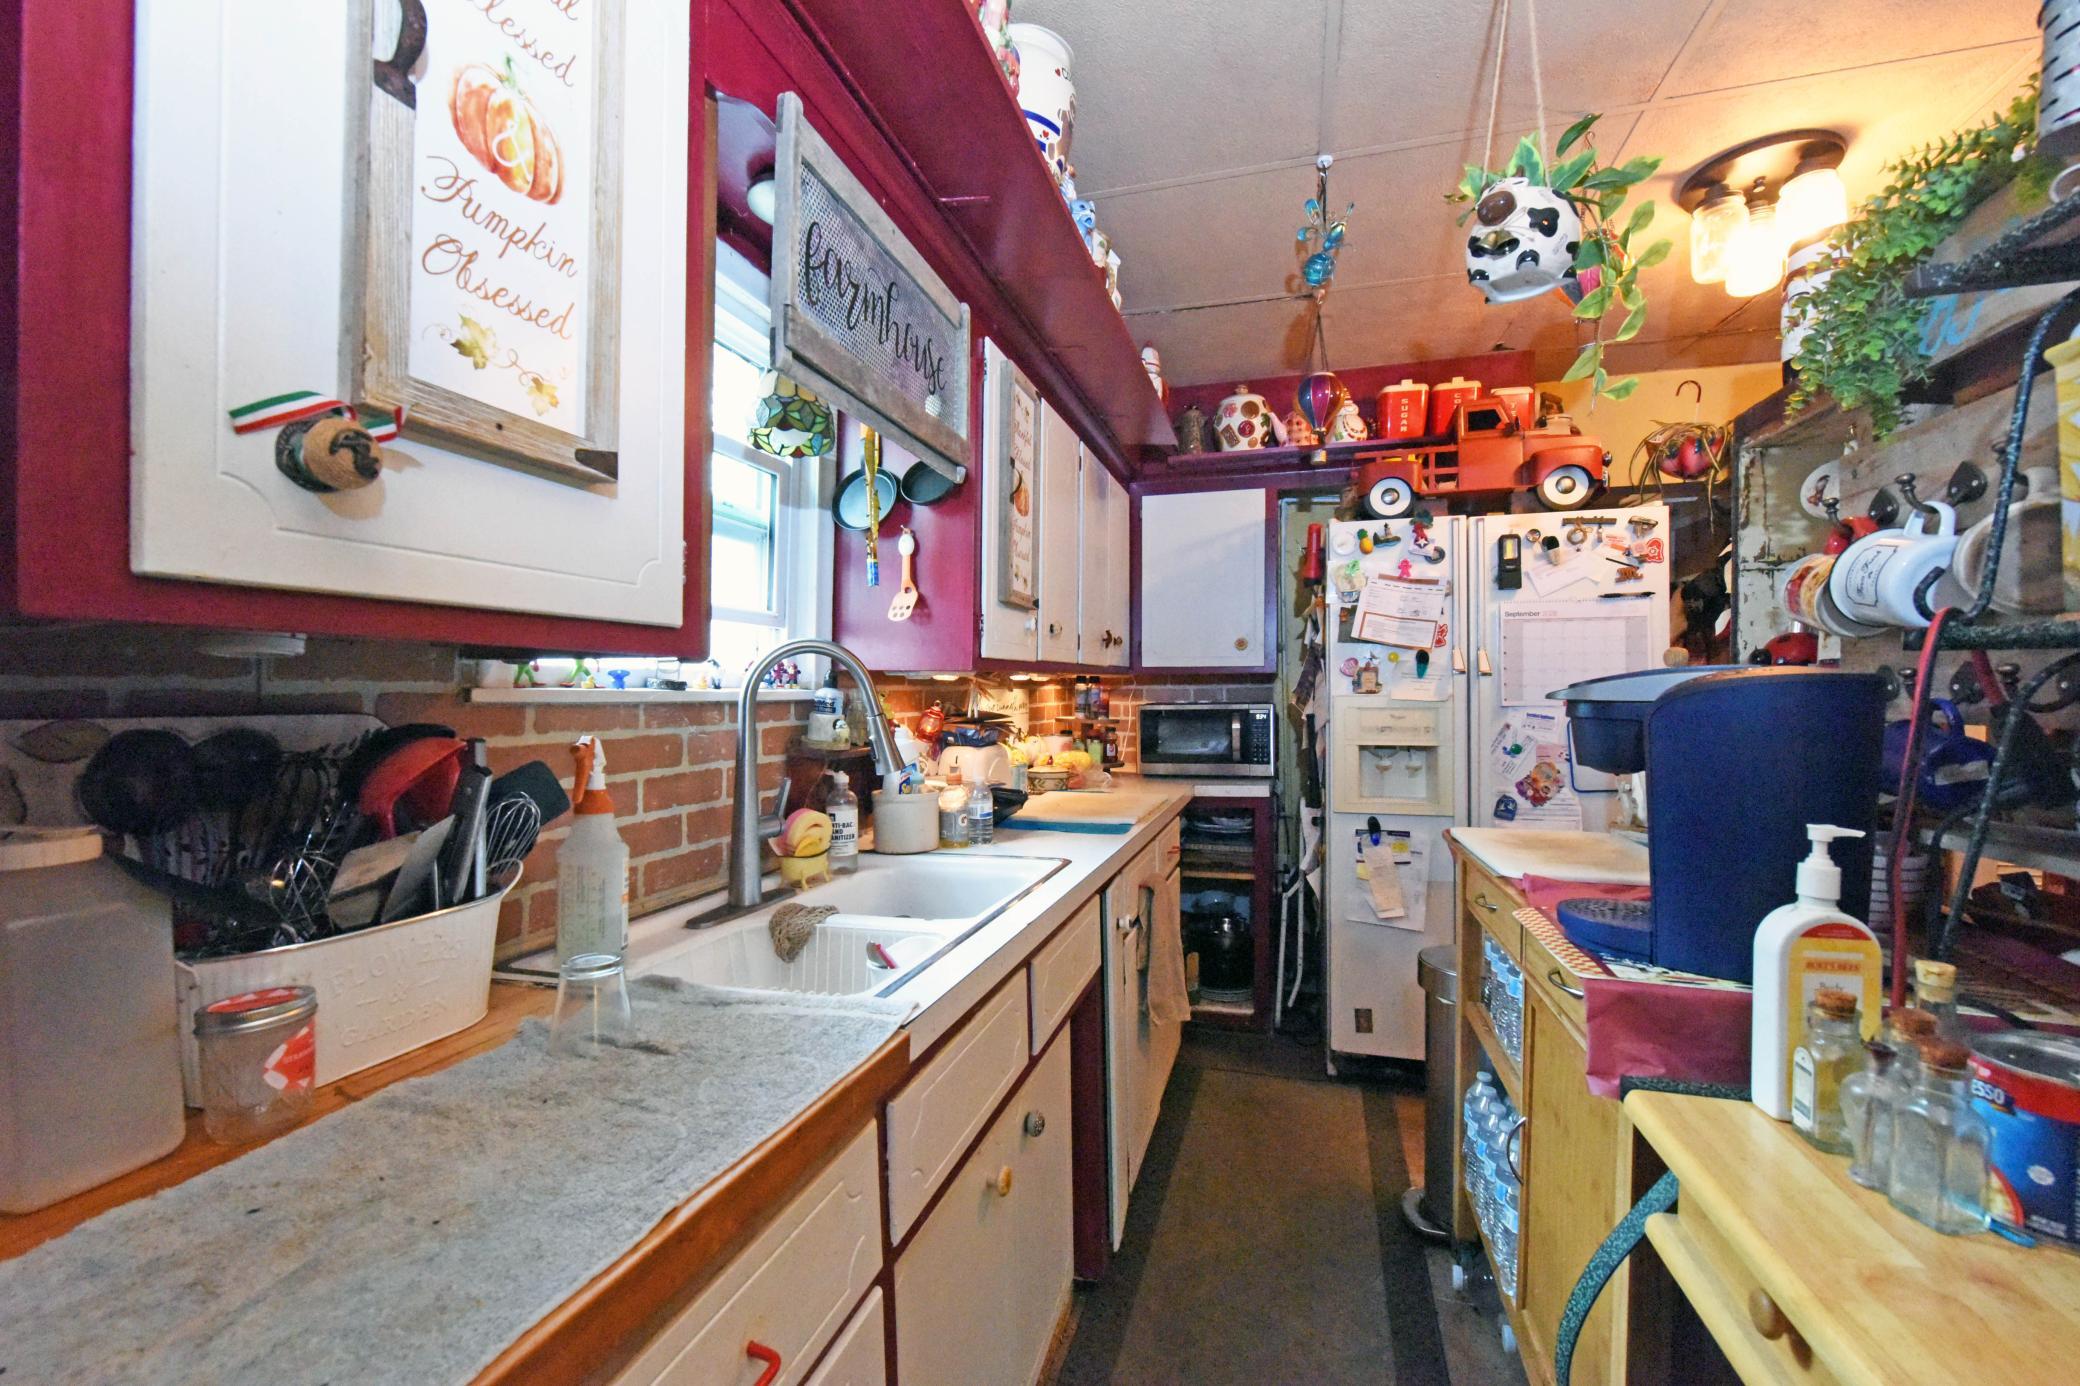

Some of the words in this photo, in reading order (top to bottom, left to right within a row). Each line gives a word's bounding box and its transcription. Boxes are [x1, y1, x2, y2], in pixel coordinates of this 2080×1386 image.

[469, 0, 578, 87] lessed
[421, 156, 577, 278] Pumpkin
[422, 234, 575, 340] Obsessed
[804, 221, 947, 395] farmhouse
[1400, 398, 1409, 432] SUGAR
[1504, 610, 1541, 618] September
